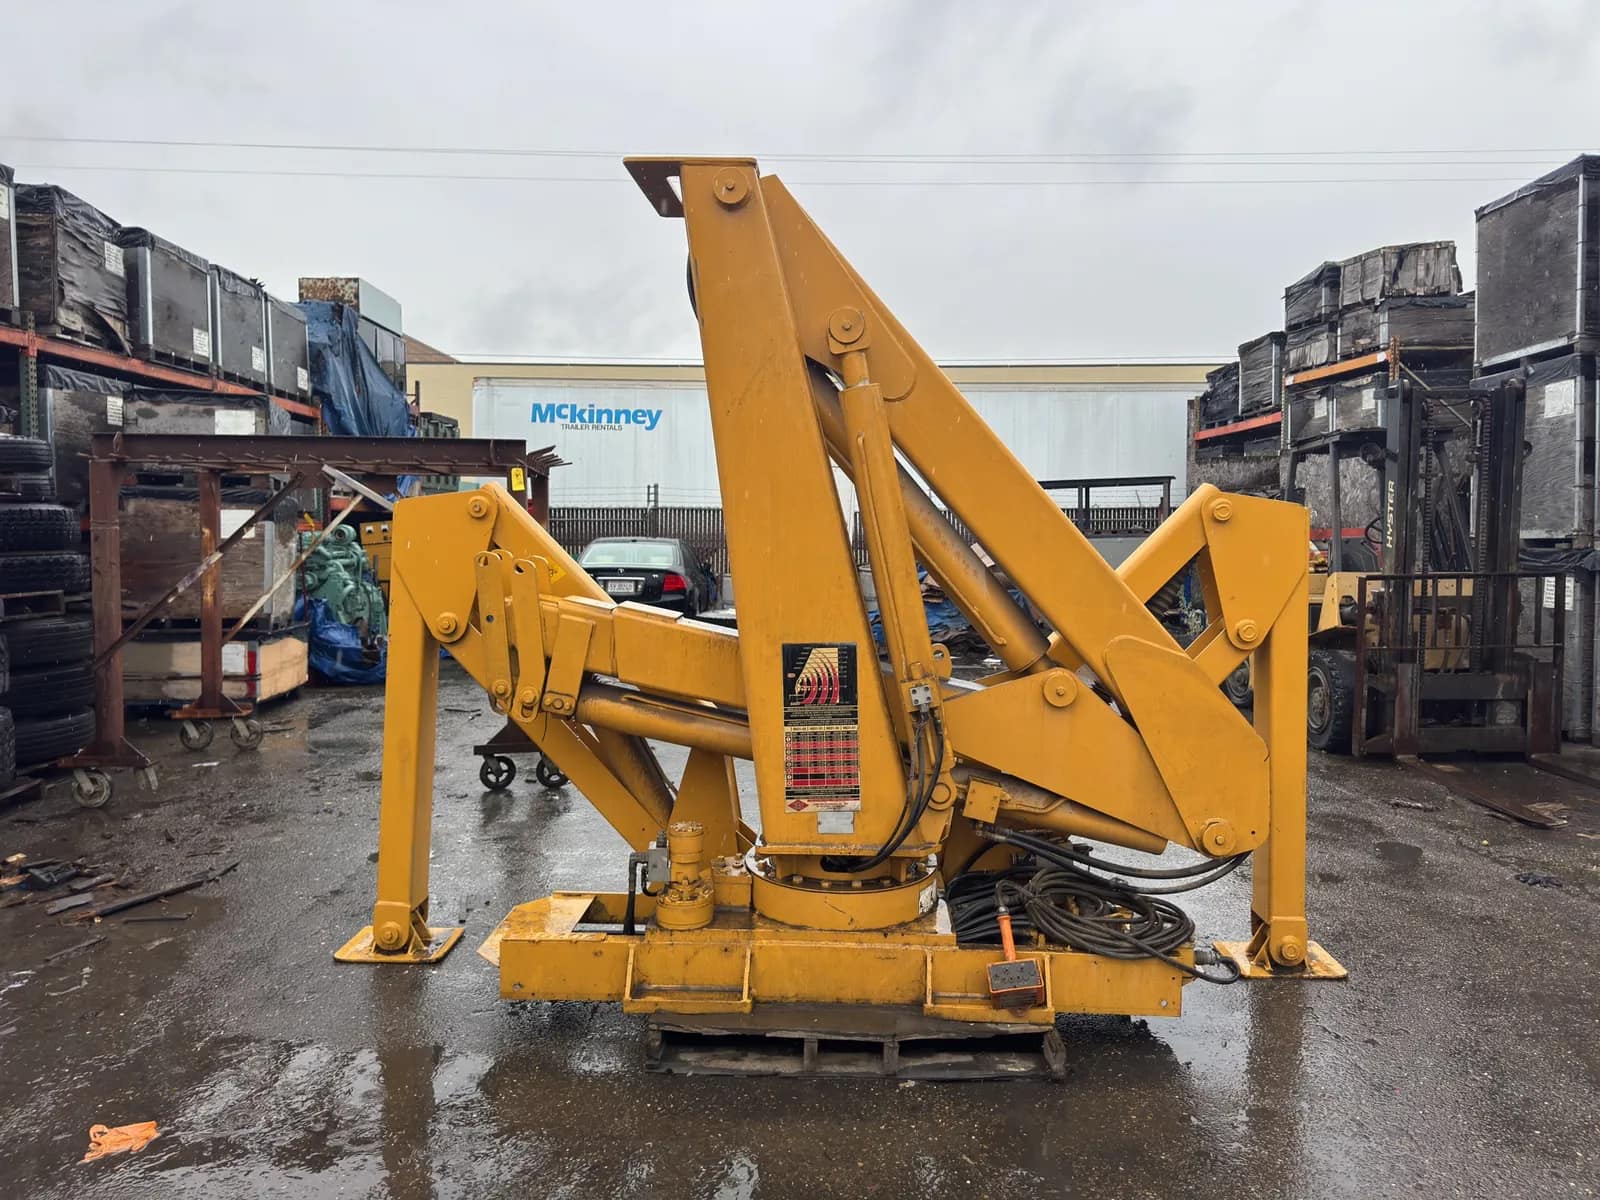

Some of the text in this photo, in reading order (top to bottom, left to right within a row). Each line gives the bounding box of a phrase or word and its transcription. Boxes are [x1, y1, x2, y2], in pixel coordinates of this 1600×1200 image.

[561, 423, 623, 431] TRAILER RENTALS
[1386, 480, 1395, 549] HYSTER
